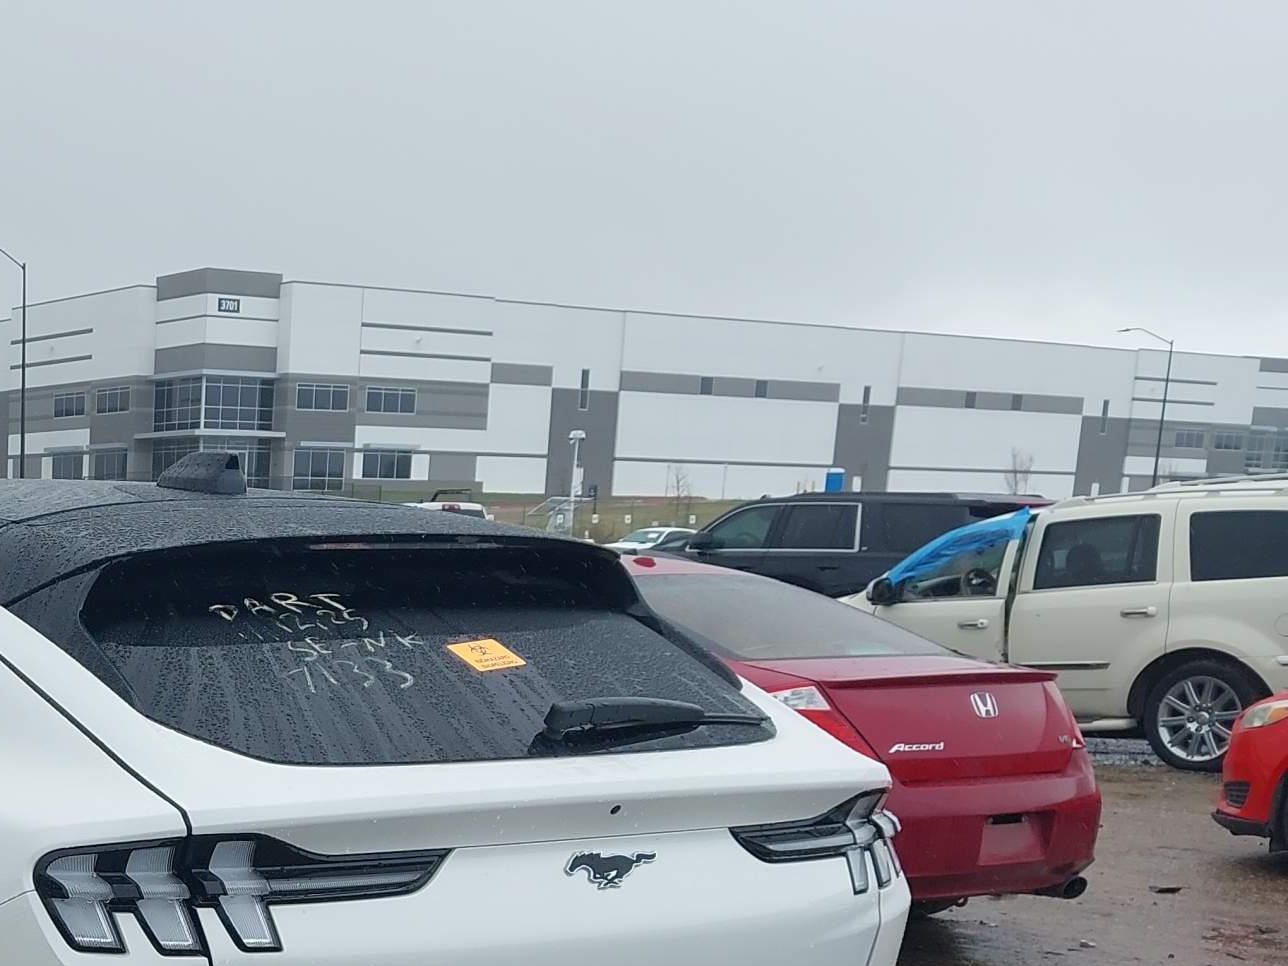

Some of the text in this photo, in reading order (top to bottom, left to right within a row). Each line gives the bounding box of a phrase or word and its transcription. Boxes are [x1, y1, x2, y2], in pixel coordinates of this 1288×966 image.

[220, 299, 238, 311] 3701
[284, 656, 414, 693] 7133
[888, 742, 945, 754] Accord
